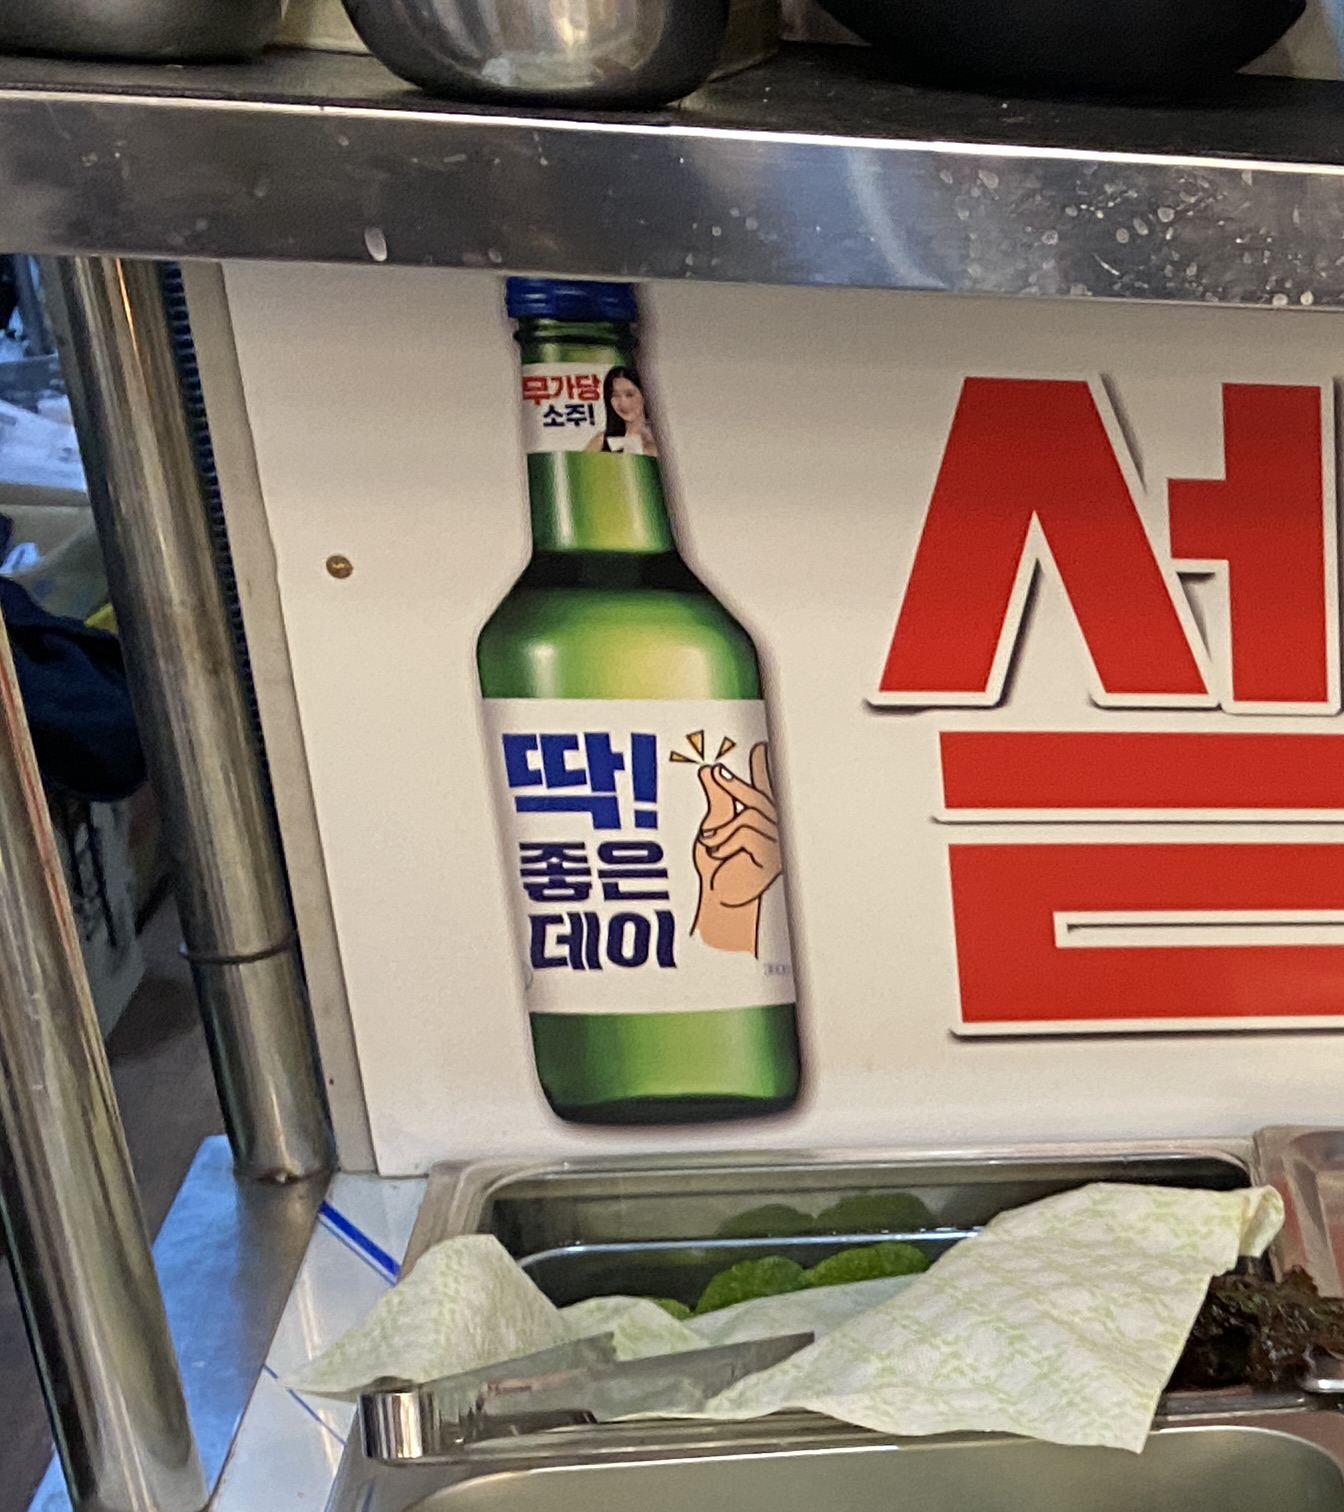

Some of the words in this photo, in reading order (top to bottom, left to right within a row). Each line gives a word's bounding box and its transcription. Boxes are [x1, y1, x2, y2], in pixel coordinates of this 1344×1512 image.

[521, 373, 602, 406] 무가당
[542, 402, 596, 427] 소주!
[501, 731, 659, 830] 딱!
[518, 840, 670, 902] 좋은
[529, 909, 678, 971] 데이
